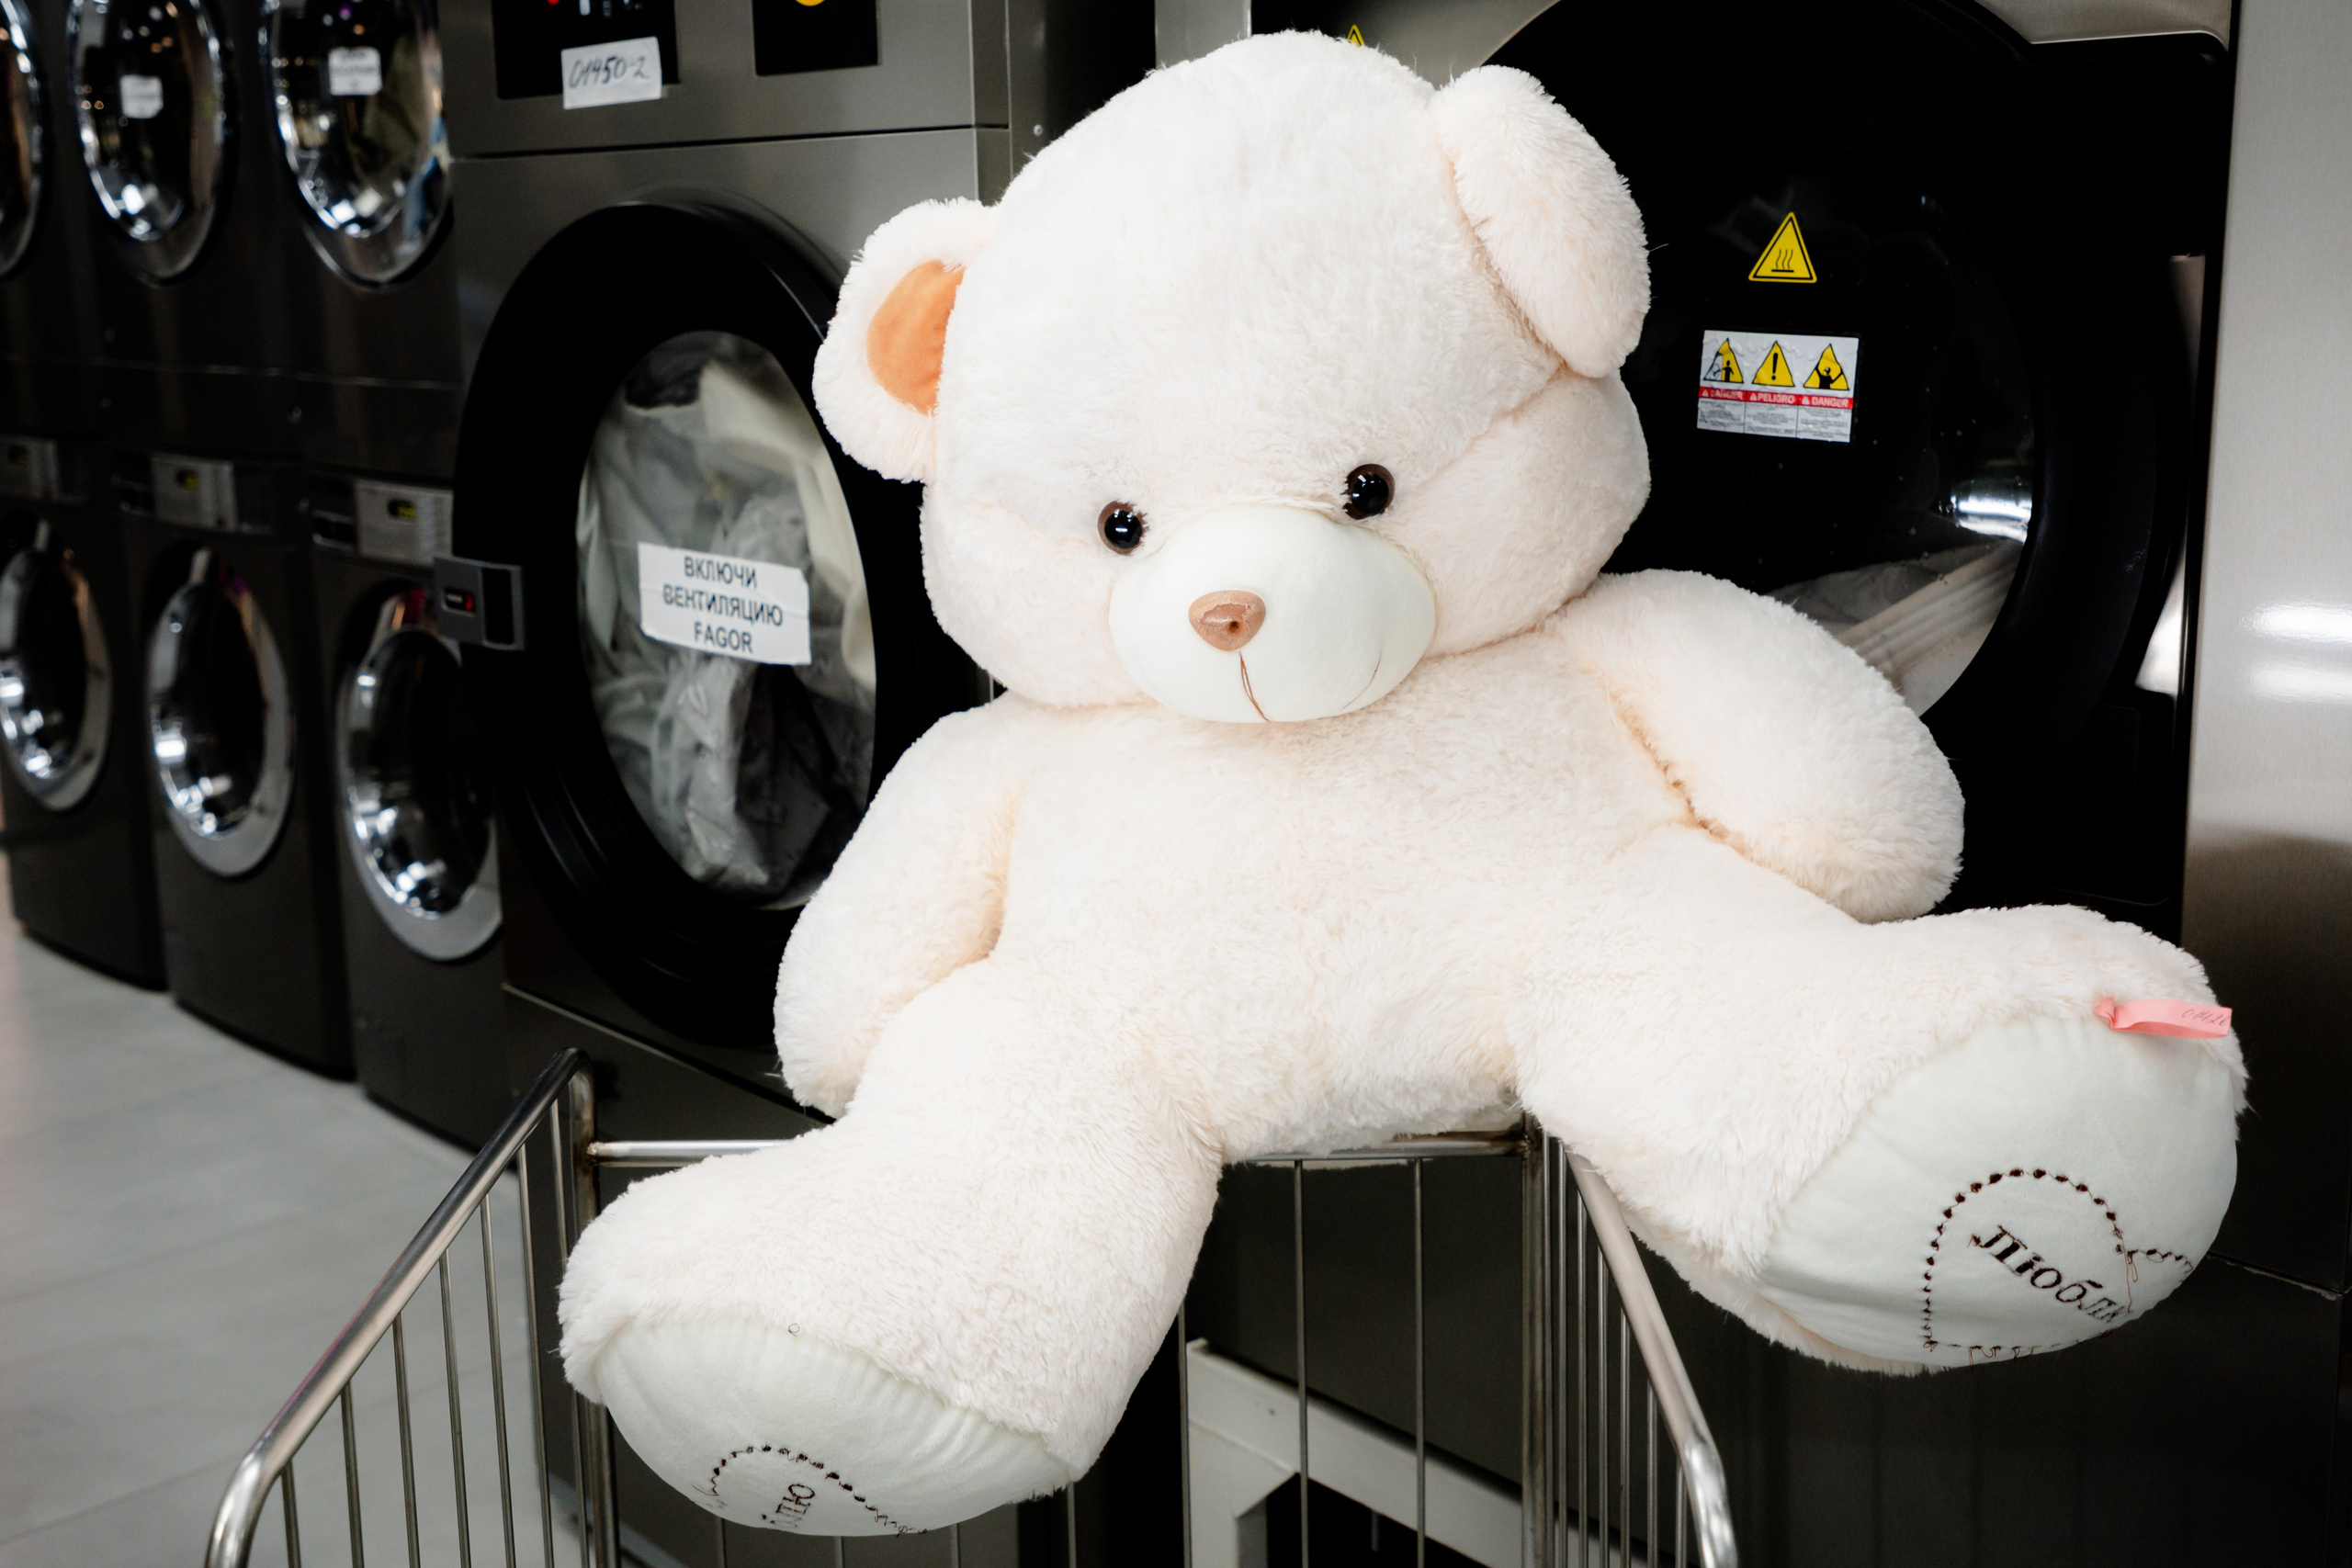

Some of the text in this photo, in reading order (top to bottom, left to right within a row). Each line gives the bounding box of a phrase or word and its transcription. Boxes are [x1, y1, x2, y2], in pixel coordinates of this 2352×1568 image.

[1757, 392, 1795, 404] PELIGRO
[1811, 397, 1849, 407] DANGER
[684, 557, 757, 589] ВКЛЮЧИ
[663, 584, 783, 626] ВЕНТИЛЯЦИЮ
[695, 621, 753, 654] FAGOR
